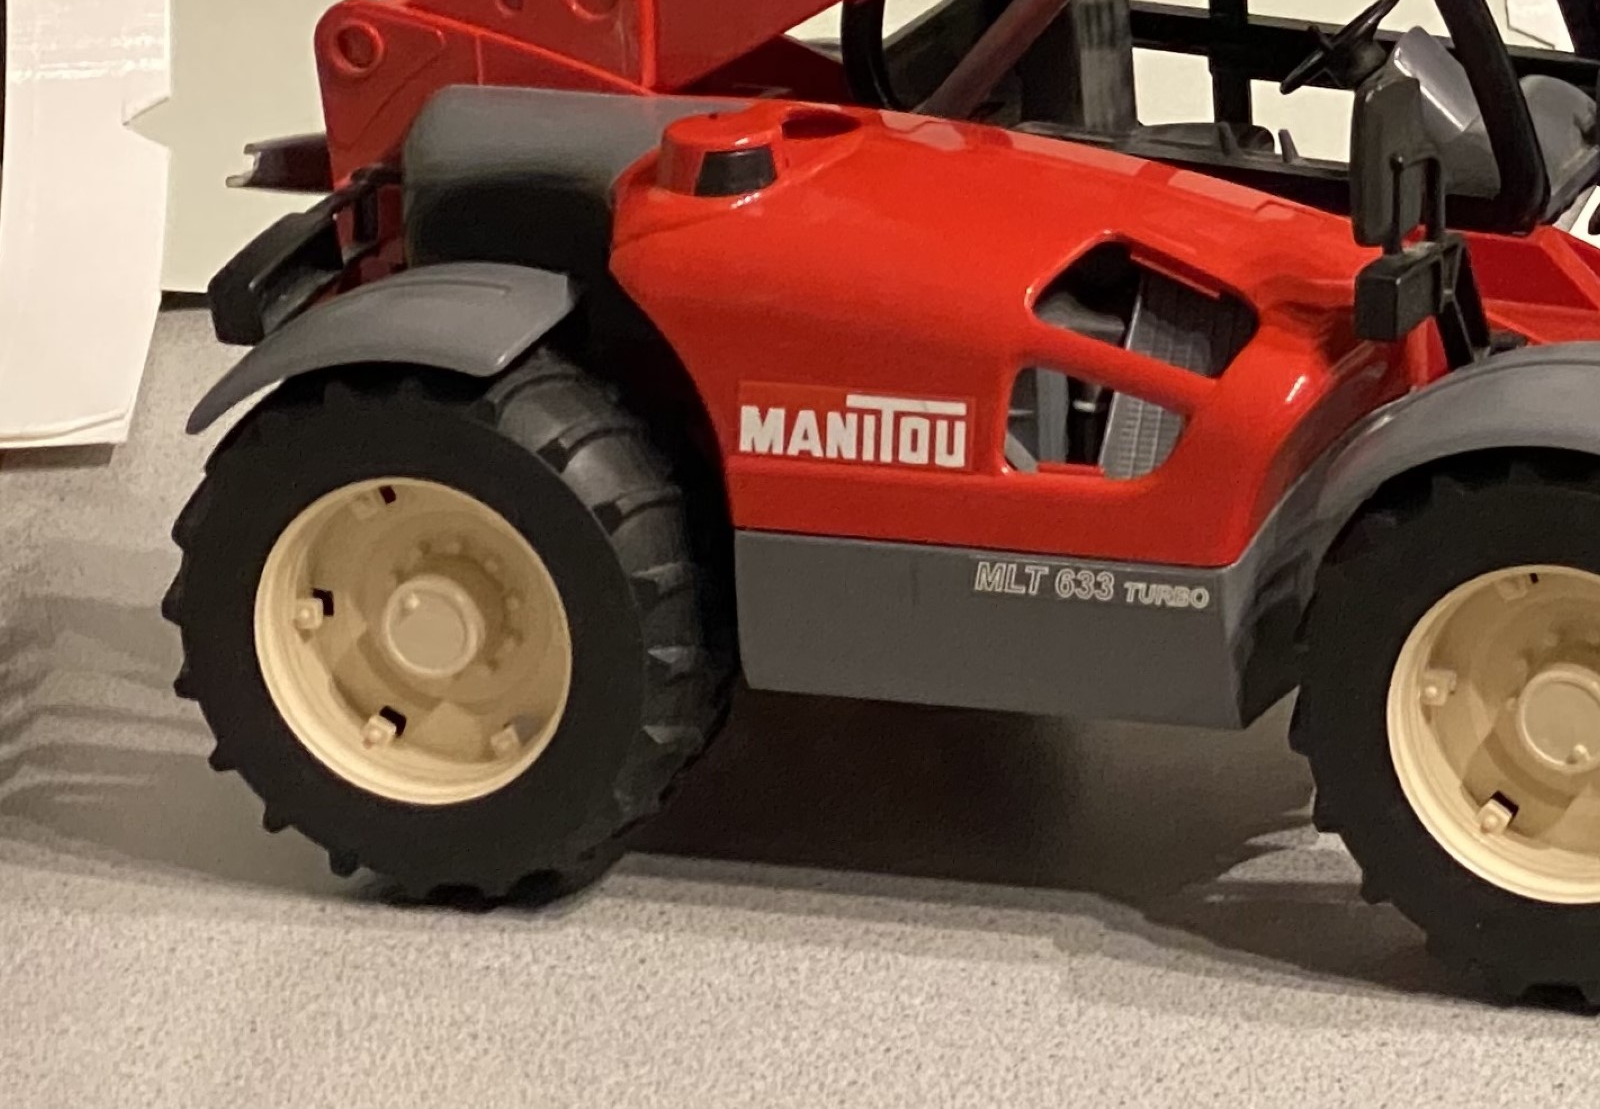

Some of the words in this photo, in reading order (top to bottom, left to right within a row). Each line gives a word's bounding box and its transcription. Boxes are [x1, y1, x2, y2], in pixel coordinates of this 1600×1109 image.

[739, 394, 967, 468] MANITOU
[974, 561, 1049, 596] MLT
[1054, 568, 1115, 601] 633
[1123, 581, 1210, 609] TURBO
